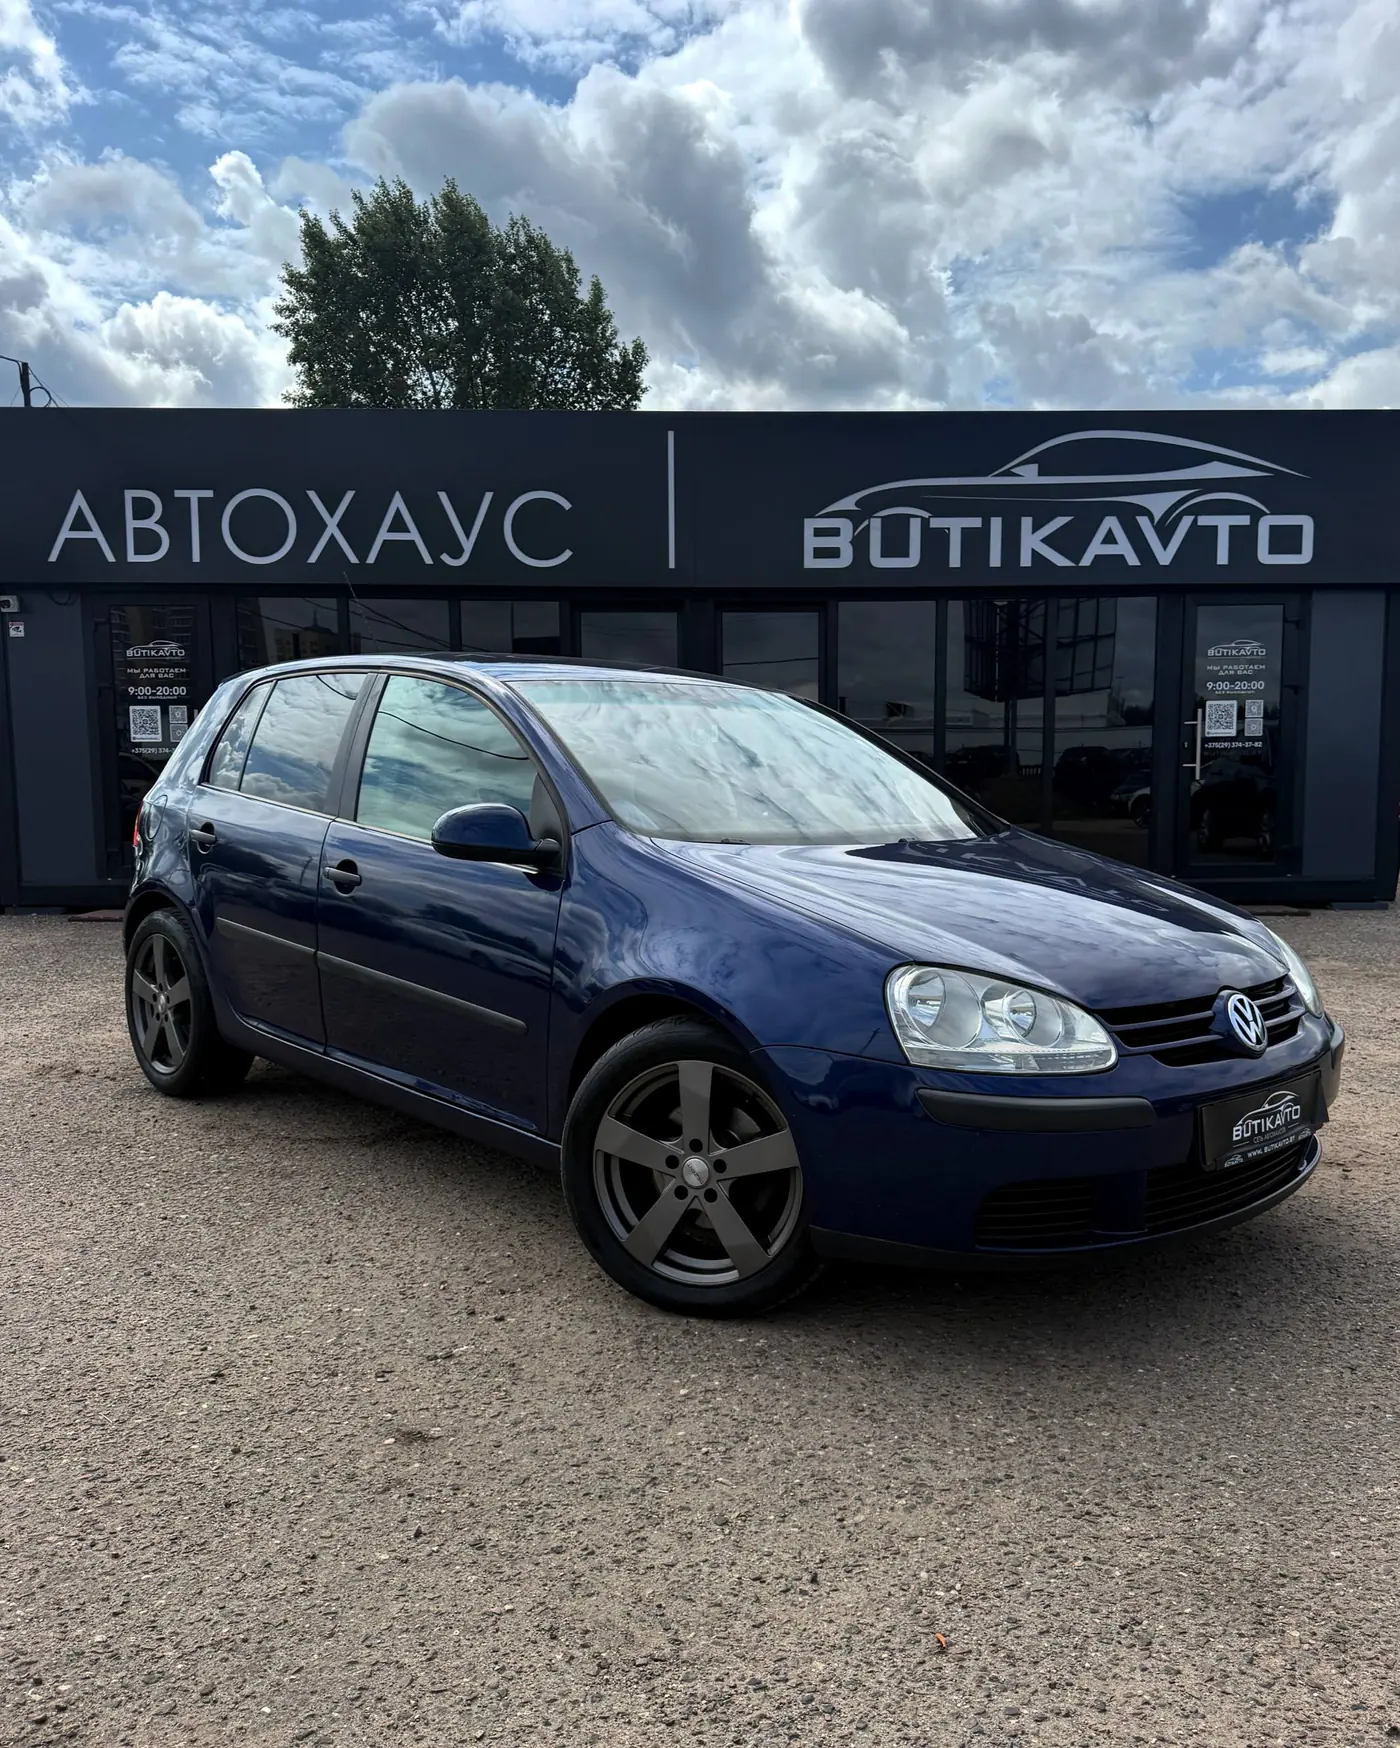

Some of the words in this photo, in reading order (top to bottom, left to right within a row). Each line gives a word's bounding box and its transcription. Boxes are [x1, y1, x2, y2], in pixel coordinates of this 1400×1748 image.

[48, 488, 573, 567] АВТОХАУС
[803, 513, 1314, 569] BUTIKAVTO
[126, 649, 185, 657] BUTIKAVTO
[1207, 648, 1266, 656] BUTIKAVTO
[1206, 681, 1265, 690] 9:00-20:00
[128, 686, 186, 695] 9:00-20:00
[1232, 1105, 1301, 1141] BUTIKAVTO
